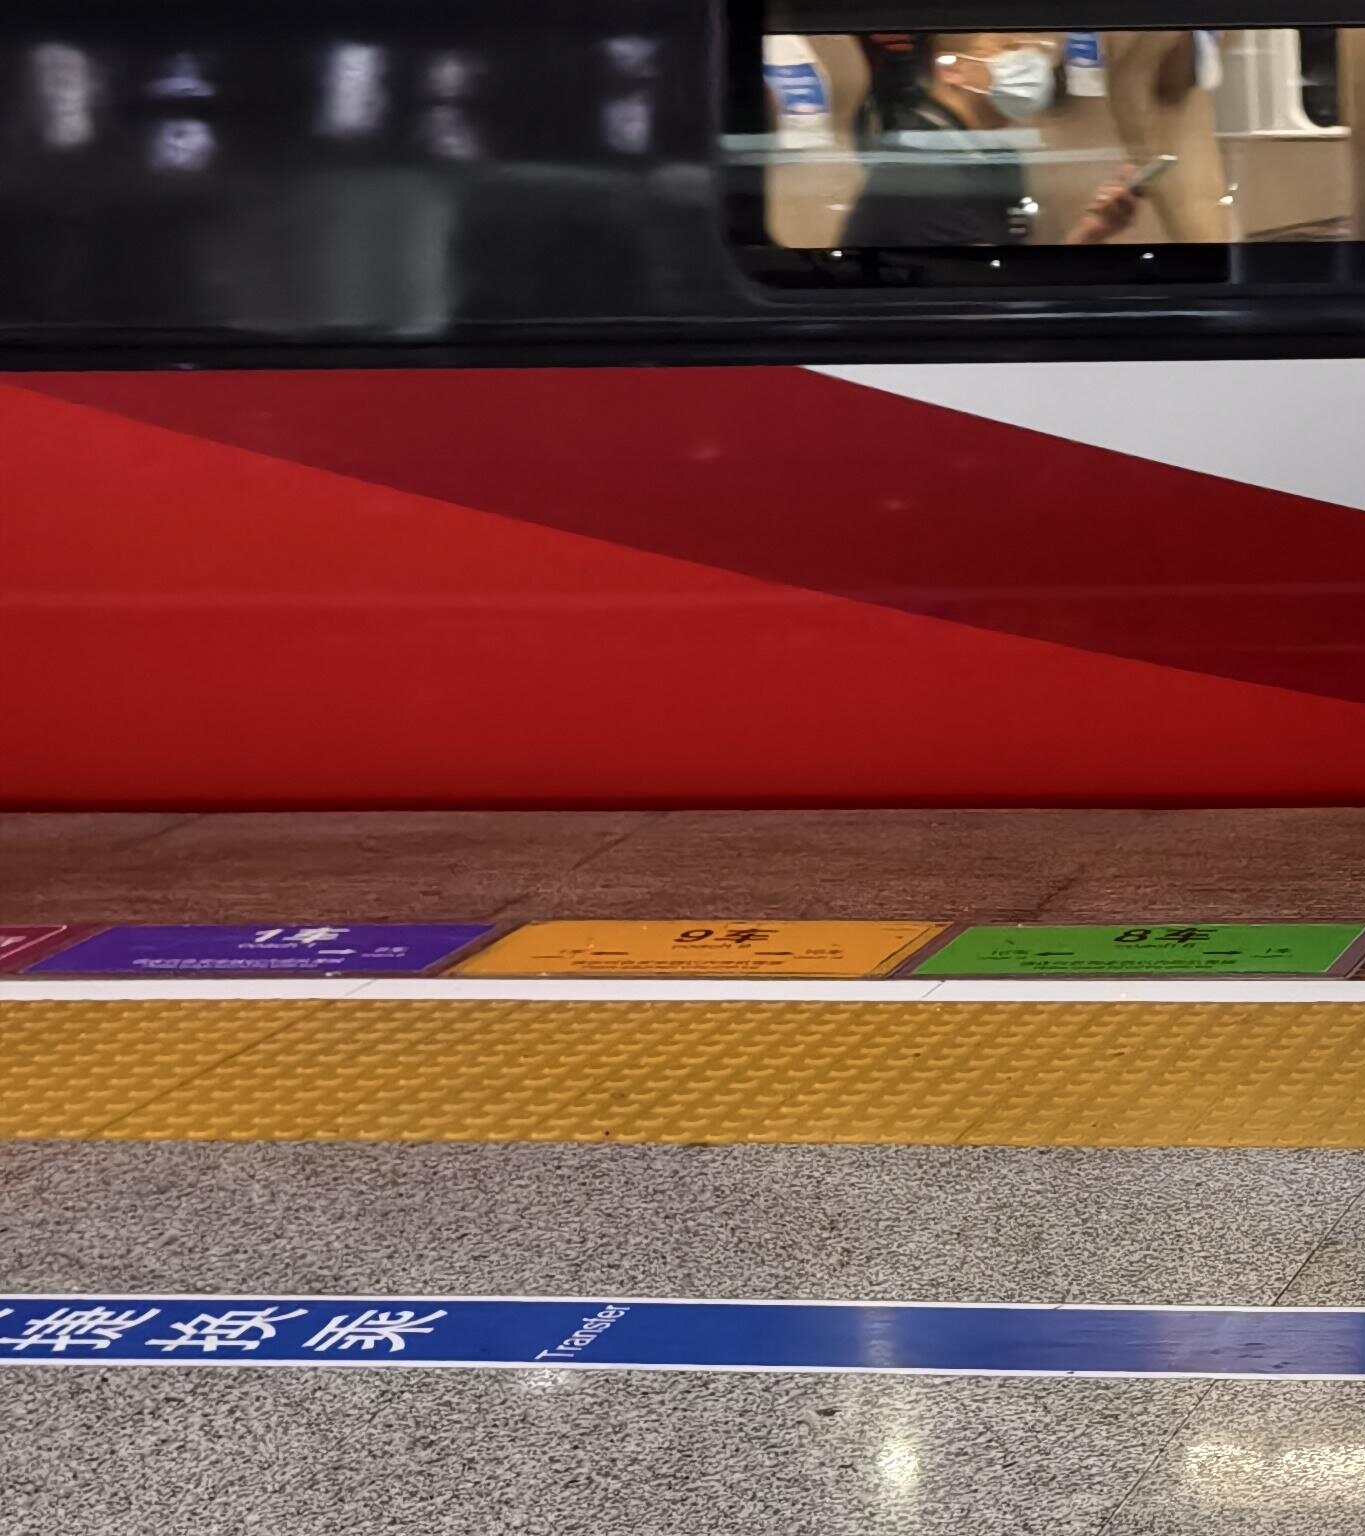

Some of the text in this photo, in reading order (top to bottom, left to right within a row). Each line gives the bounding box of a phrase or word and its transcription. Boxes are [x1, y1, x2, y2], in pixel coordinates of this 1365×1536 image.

[0, 1305, 448, 1353] 捷换乘
[533, 1304, 632, 1360] Transfer
